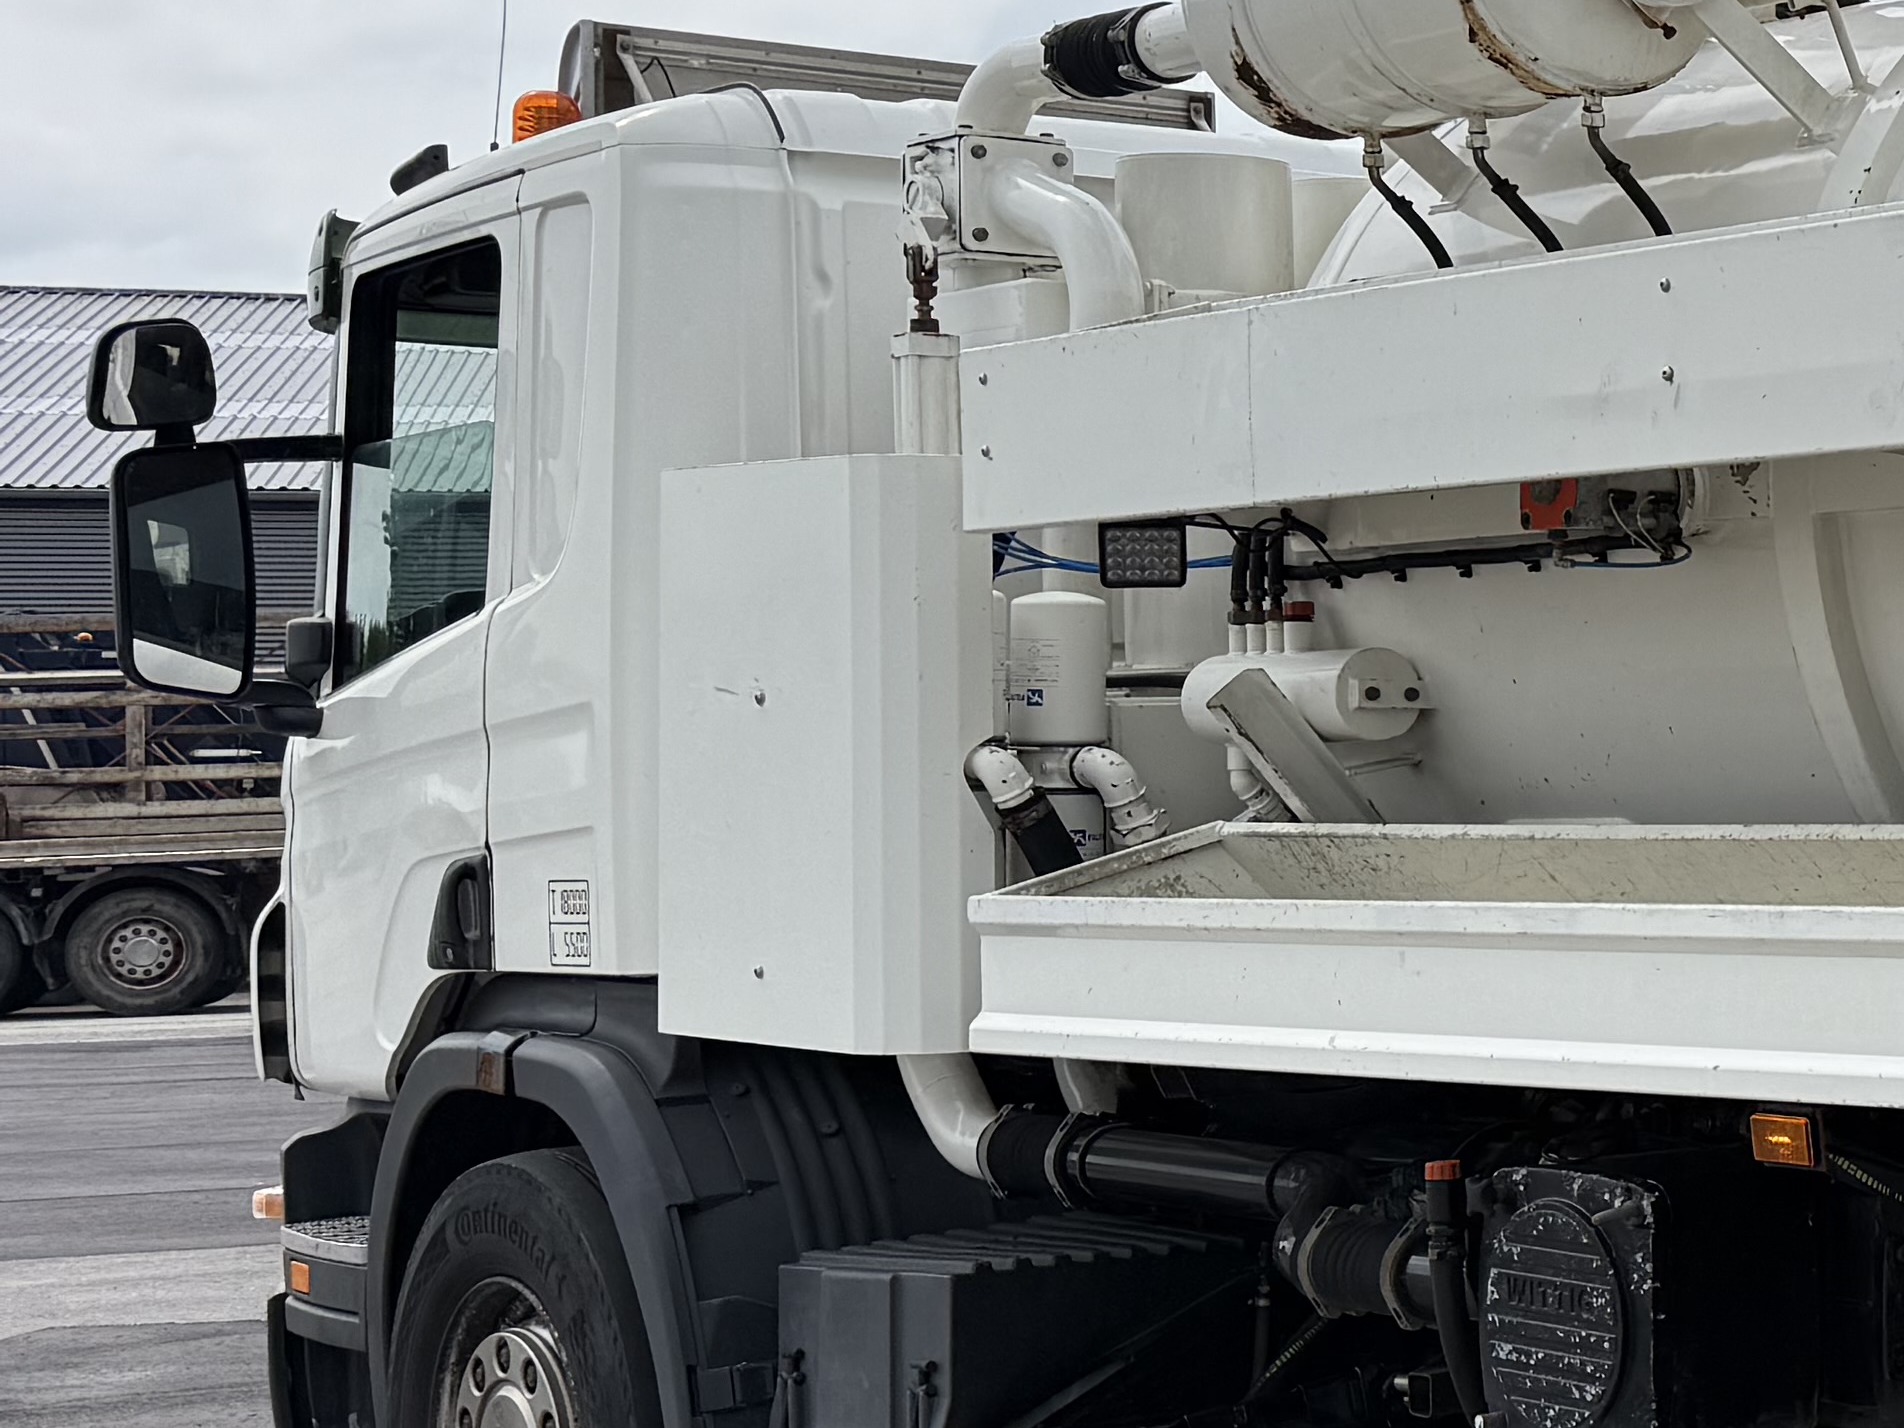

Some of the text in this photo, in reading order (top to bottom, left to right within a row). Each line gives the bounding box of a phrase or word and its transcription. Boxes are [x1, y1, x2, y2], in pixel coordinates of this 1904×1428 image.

[551, 889, 557, 915] T
[552, 931, 557, 957] L
[455, 1201, 557, 1284] Continental
